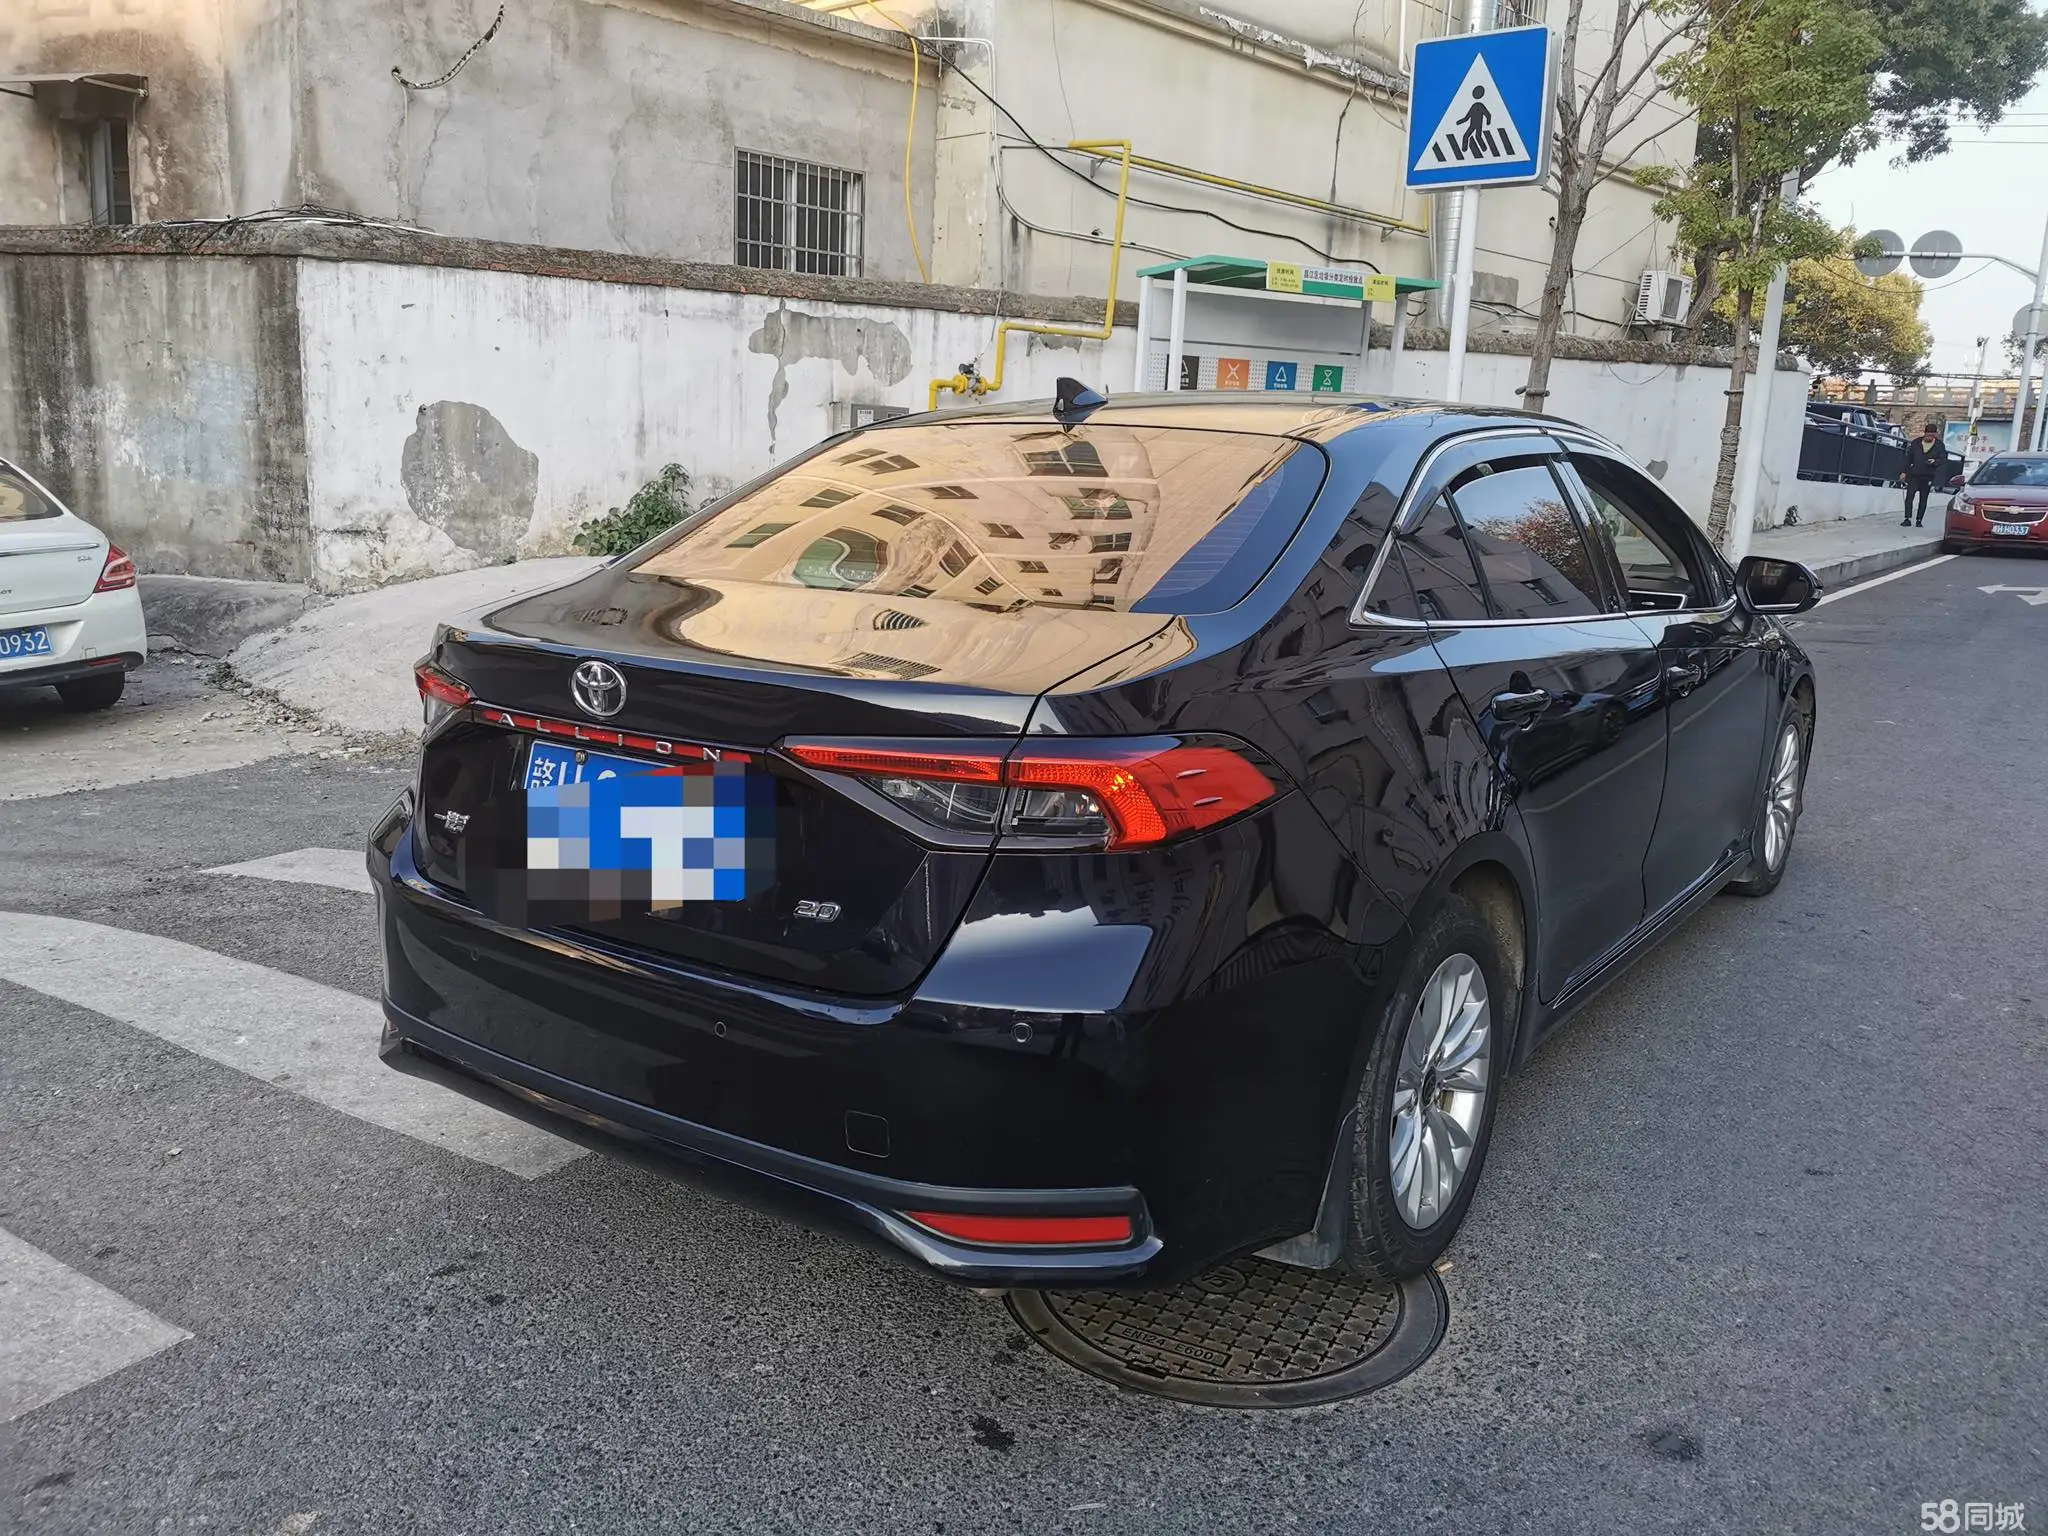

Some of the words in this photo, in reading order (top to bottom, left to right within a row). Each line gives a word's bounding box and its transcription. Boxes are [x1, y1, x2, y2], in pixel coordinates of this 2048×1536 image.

[0, 631, 49, 655] 0932
[498, 712, 722, 763] ALLION
[1174, 1342, 1214, 1361] E600
